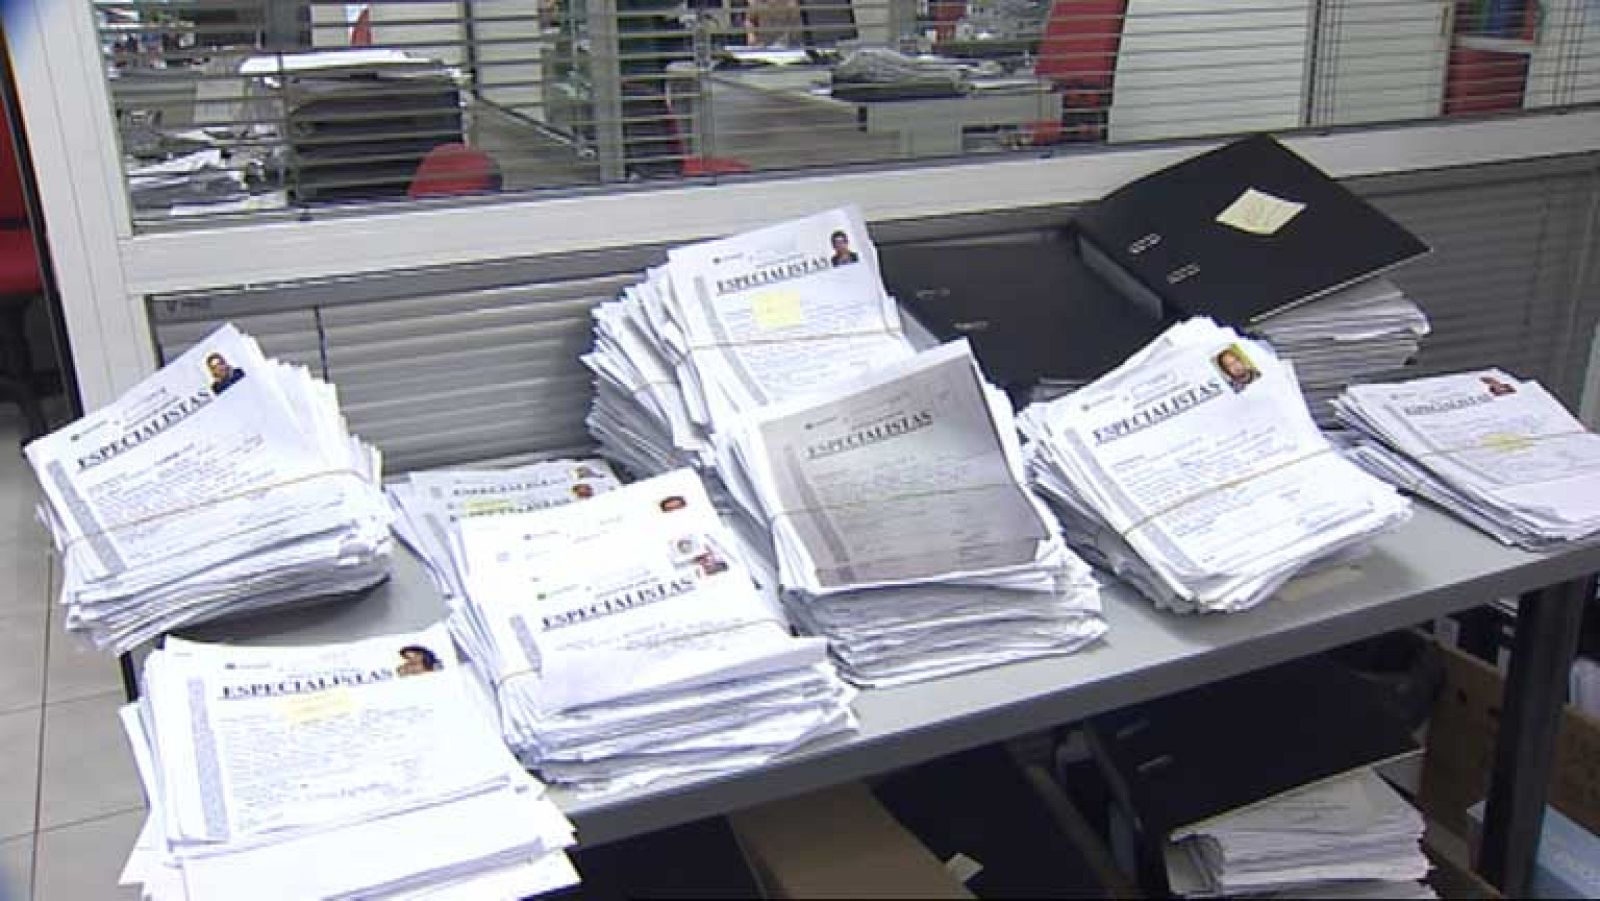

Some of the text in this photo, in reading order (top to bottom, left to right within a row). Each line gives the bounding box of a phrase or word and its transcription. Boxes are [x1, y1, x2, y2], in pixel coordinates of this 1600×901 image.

[717, 257, 829, 293] ESPECIALISTAS
[79, 390, 212, 470] ESPECIALISTAS
[808, 410, 932, 459] ESPECIALISTAS
[1094, 381, 1224, 445] ESPECIALISTAS
[541, 577, 695, 630] ESPECIALISTAS
[221, 667, 394, 698] ESPECIALISTAS
